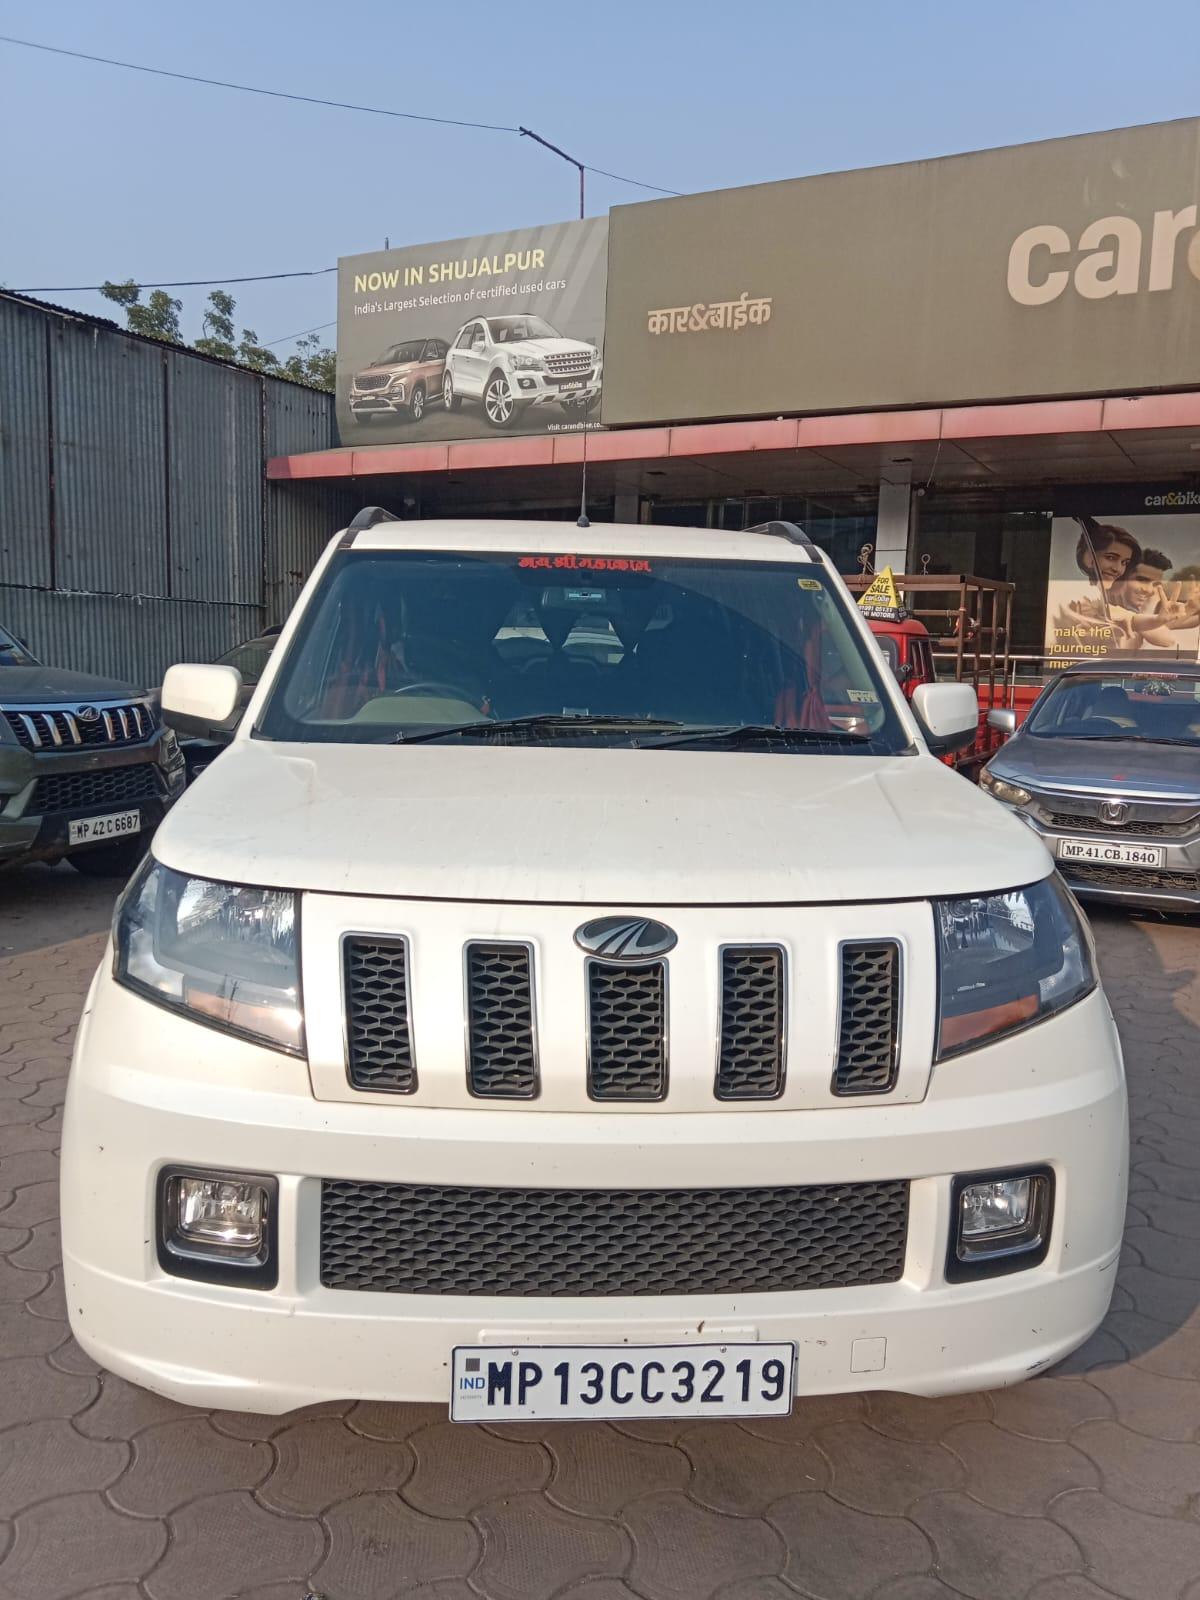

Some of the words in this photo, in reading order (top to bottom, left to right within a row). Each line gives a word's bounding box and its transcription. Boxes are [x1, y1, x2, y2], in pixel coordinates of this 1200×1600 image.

[1007, 204, 1200, 306] car
[354, 269, 399, 293] NOW
[404, 266, 423, 286] IN
[428, 249, 545, 283] SHUJALPUR
[354, 302, 382, 315] India's
[384, 298, 417, 311] Largest
[419, 292, 462, 306] Selection
[464, 289, 475, 301] of
[476, 284, 517, 300] certified
[519, 280, 544, 294] used
[545, 279, 566, 290] cars
[647, 291, 773, 335] कार&बाईक
[547, 423, 560, 431] Visit
[561, 422, 601, 430] carandbike.co
[870, 584, 891, 594] SALE
[1053, 626, 1086, 637] make
[1089, 626, 1112, 638] the
[1049, 643, 1107, 656] journeys
[92, 821, 105, 835] 42
[107, 820, 113, 833] C
[115, 815, 138, 831] 6687
[1065, 845, 1155, 863] MP.41.CB.1840
[459, 1377, 485, 1390] IND
[487, 1359, 786, 1405] MP13CC3219
